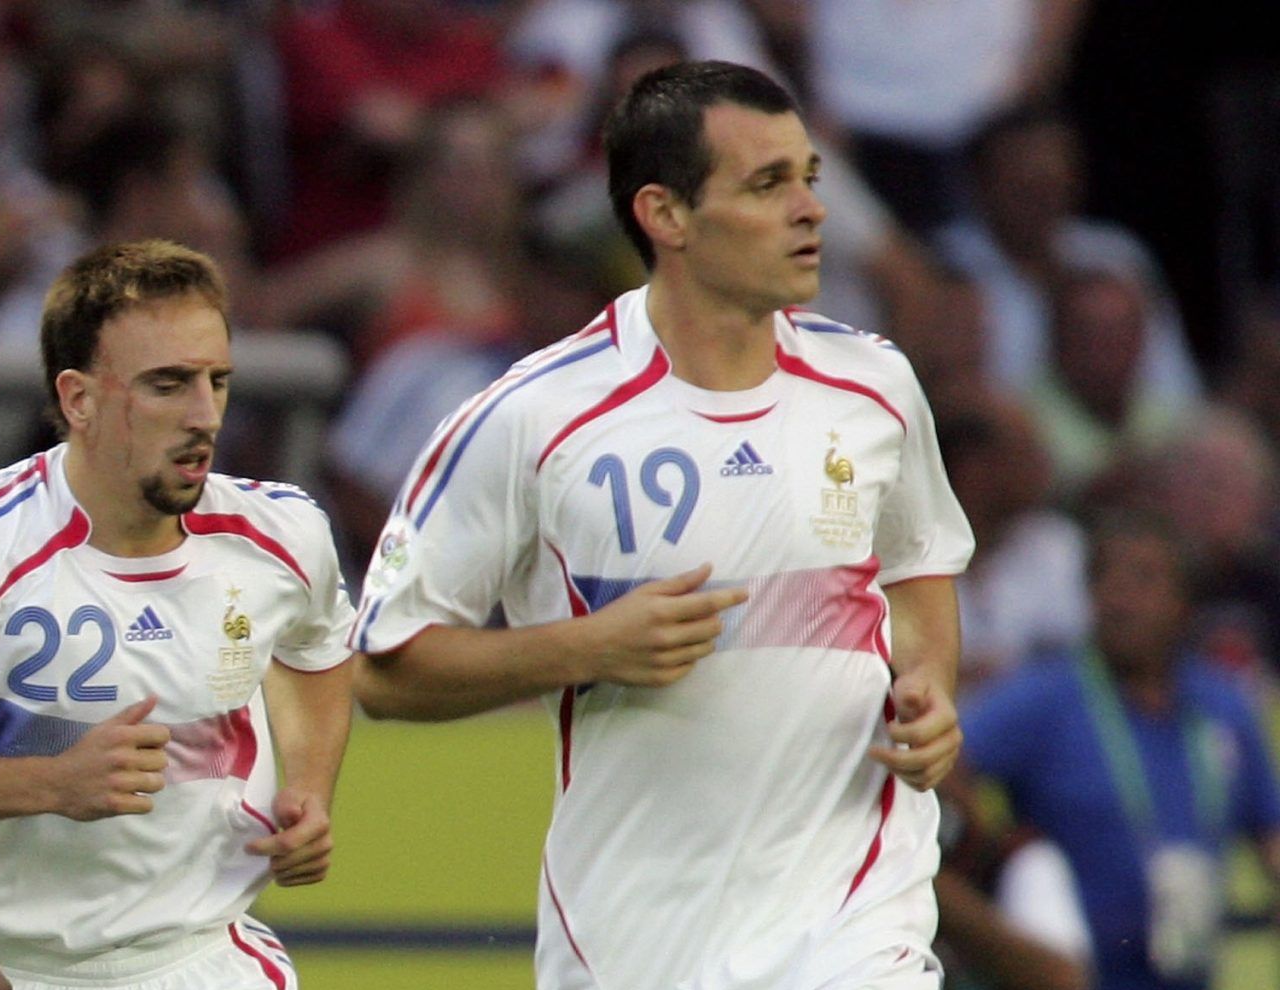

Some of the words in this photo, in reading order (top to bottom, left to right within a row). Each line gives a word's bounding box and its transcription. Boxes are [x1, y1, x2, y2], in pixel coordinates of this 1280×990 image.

[719, 463, 773, 477] adidas
[587, 446, 701, 554] 19
[4, 604, 119, 702] 22
[124, 628, 174, 642] adidas
